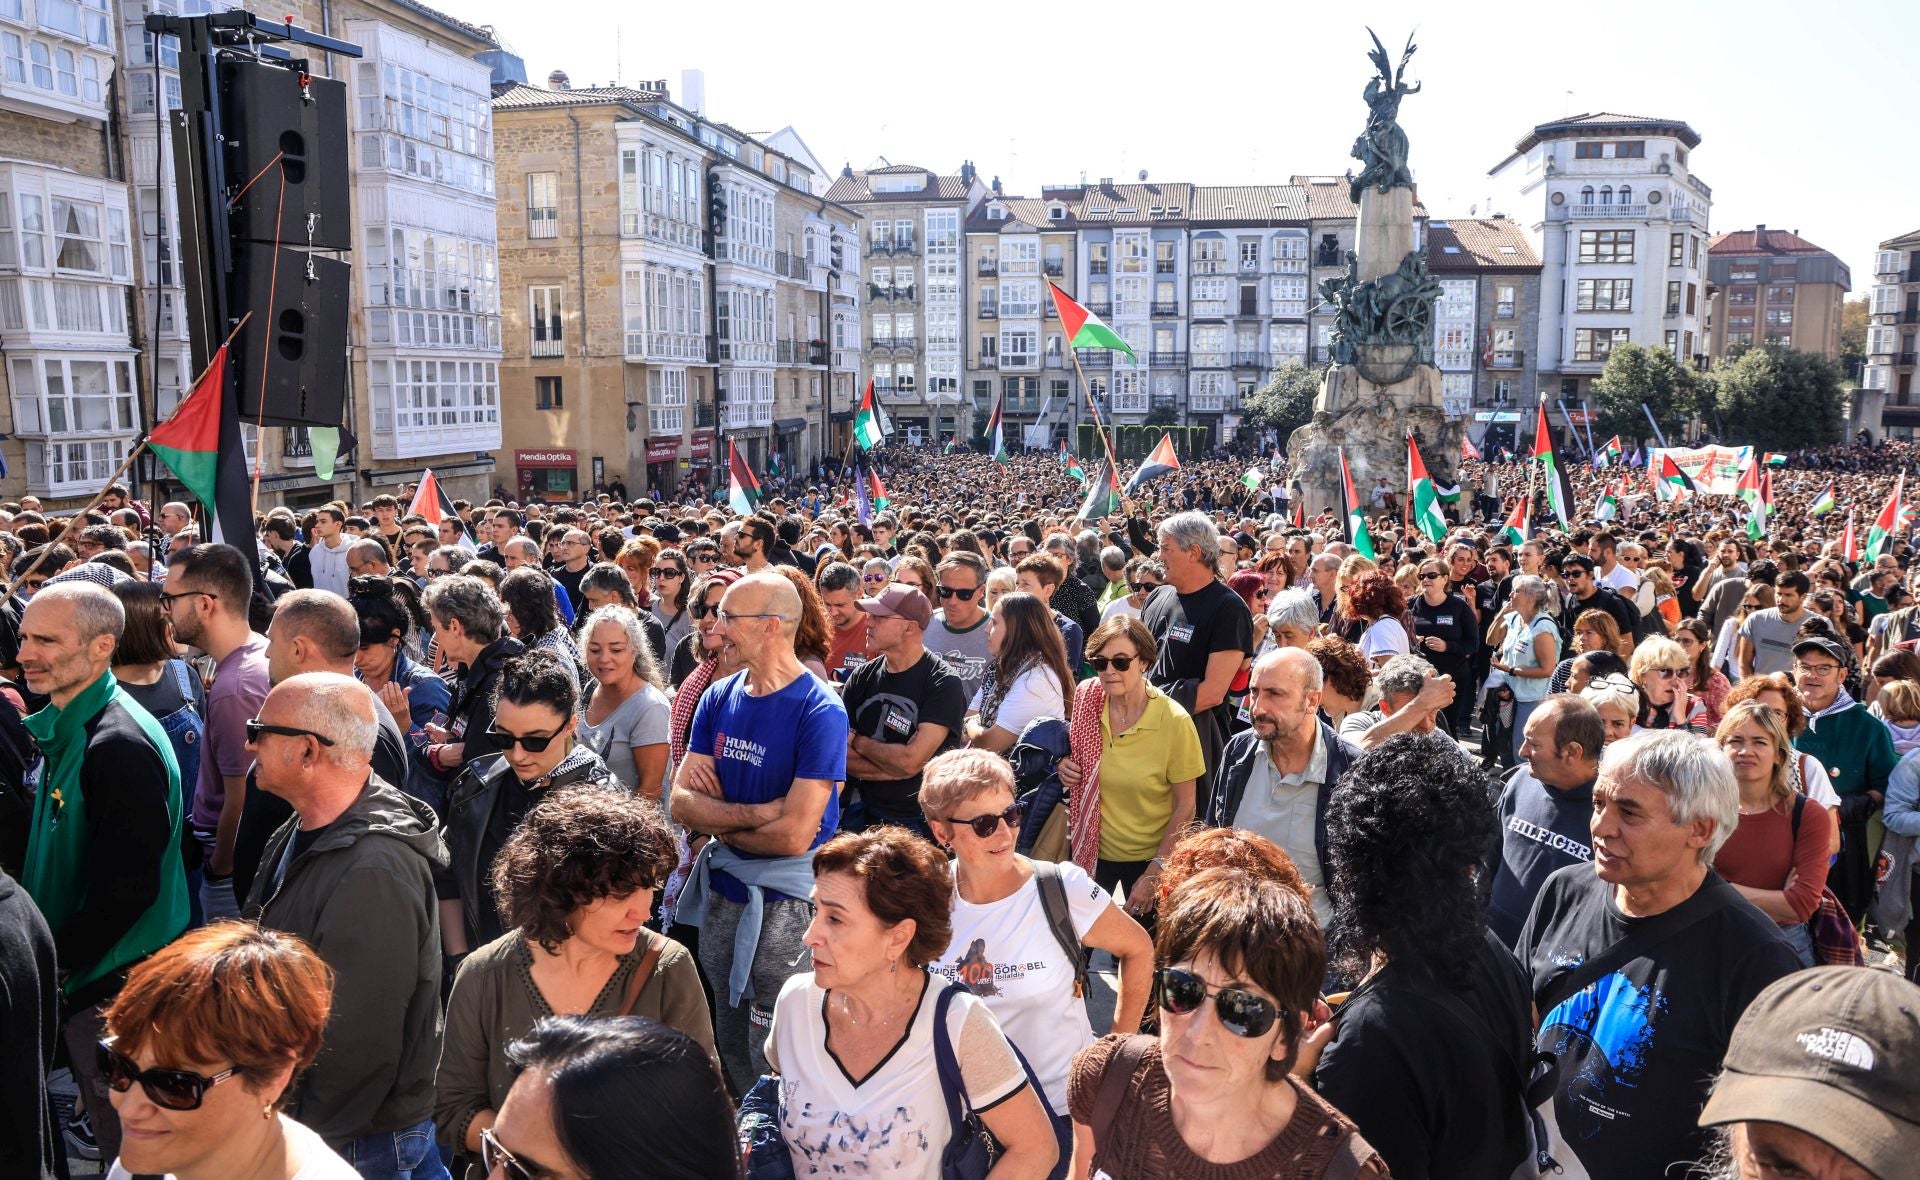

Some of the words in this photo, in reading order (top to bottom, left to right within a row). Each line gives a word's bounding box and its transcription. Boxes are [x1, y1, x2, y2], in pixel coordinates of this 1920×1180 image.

[519, 453, 546, 461] Mendia
[546, 453, 571, 462] Optika
[725, 736, 767, 756] HUMAN
[722, 747, 764, 767] EXCHANGE
[1507, 817, 1592, 862] HILFIGER
[960, 962, 994, 984] 100
[1796, 1033, 1848, 1050] NORTH
